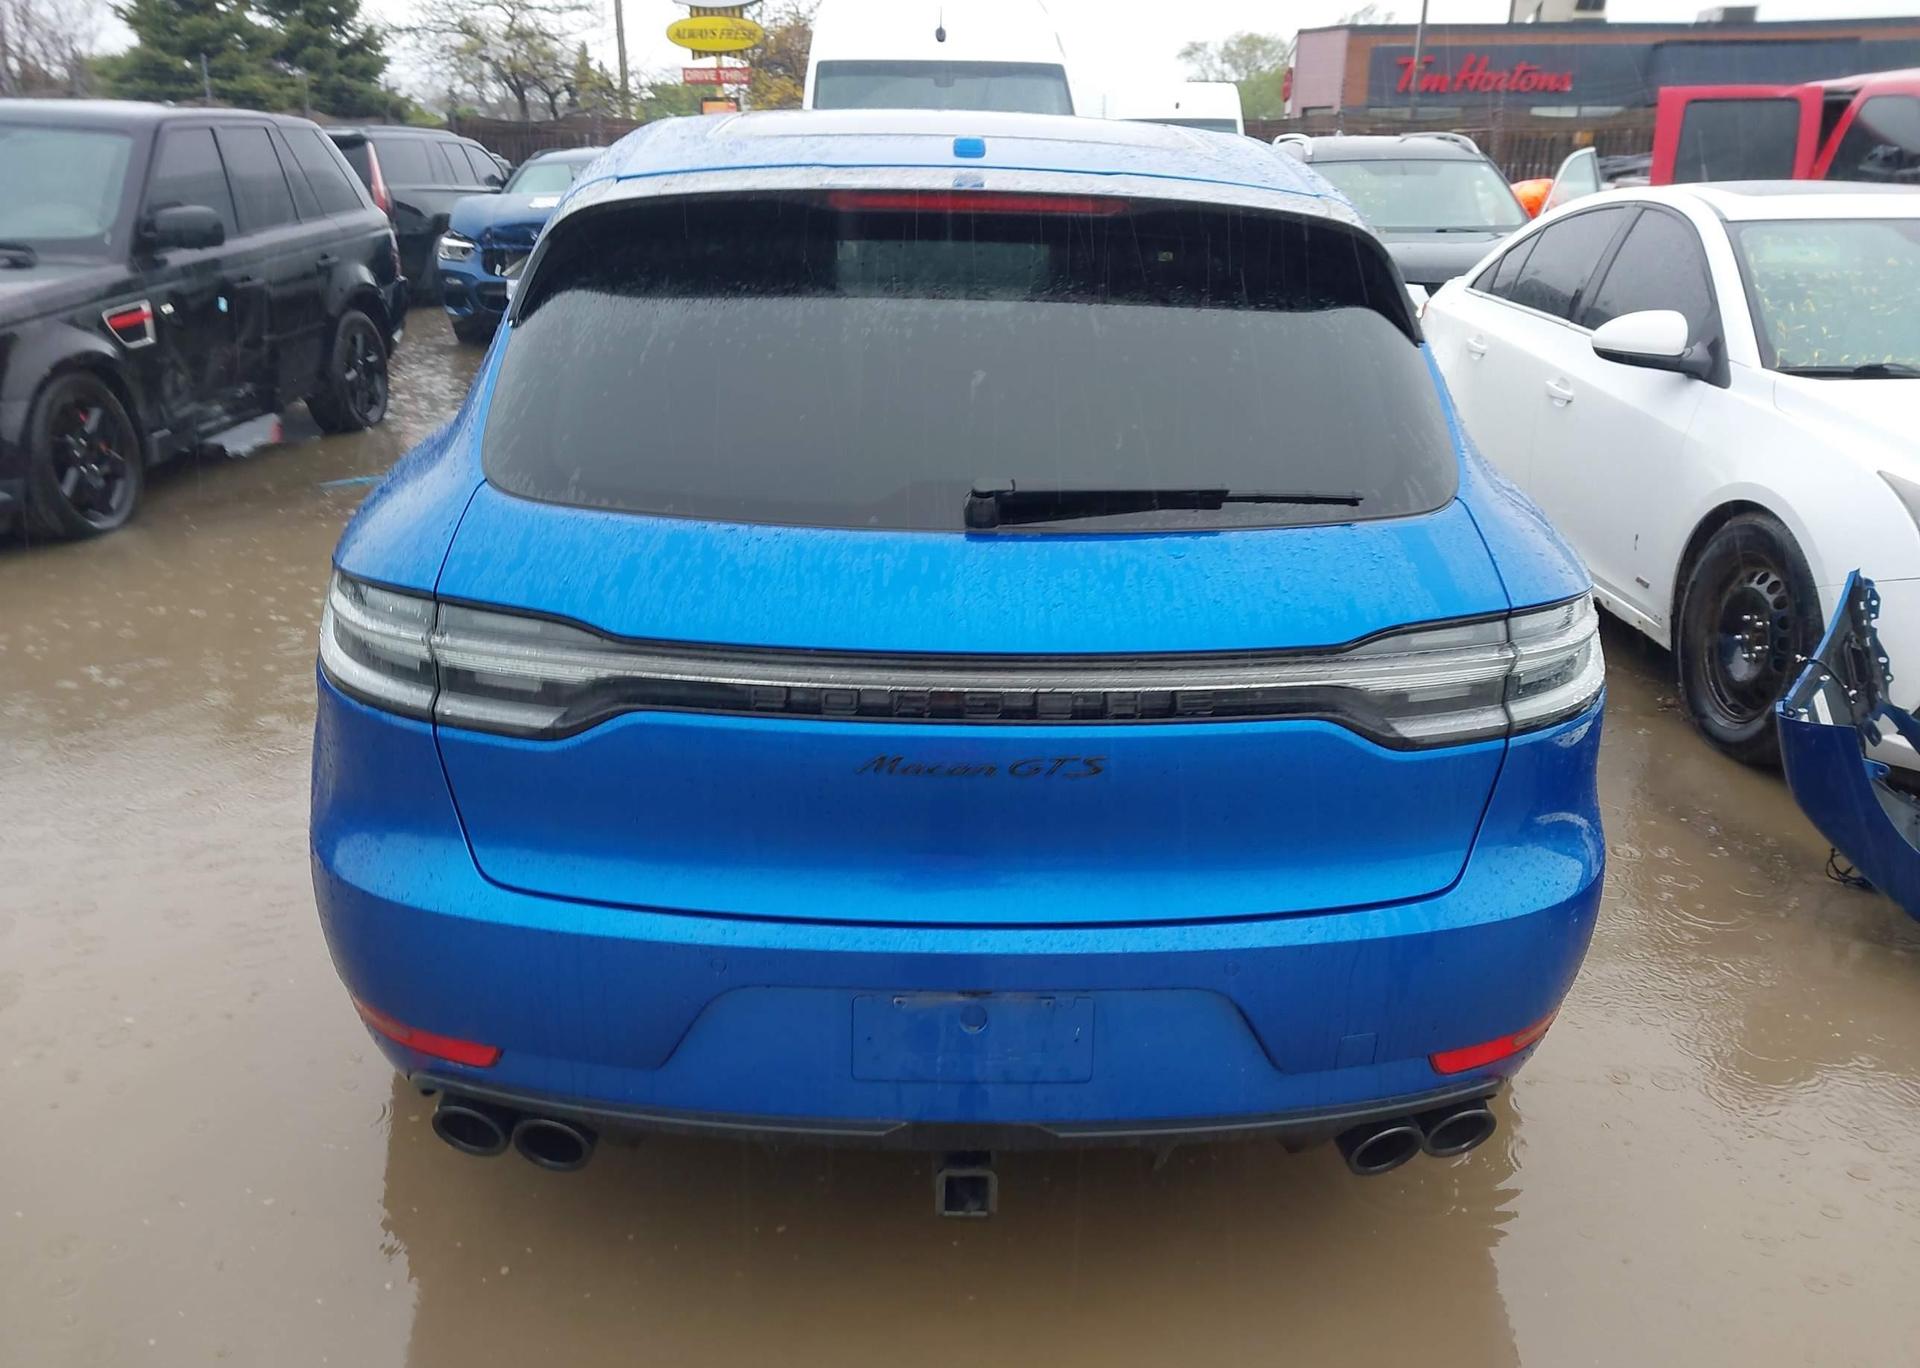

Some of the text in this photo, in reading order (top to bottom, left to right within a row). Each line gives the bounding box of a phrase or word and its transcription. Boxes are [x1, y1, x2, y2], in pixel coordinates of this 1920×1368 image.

[1452, 52, 1573, 93] Hortons
[855, 753, 1107, 778] Macan GTS
